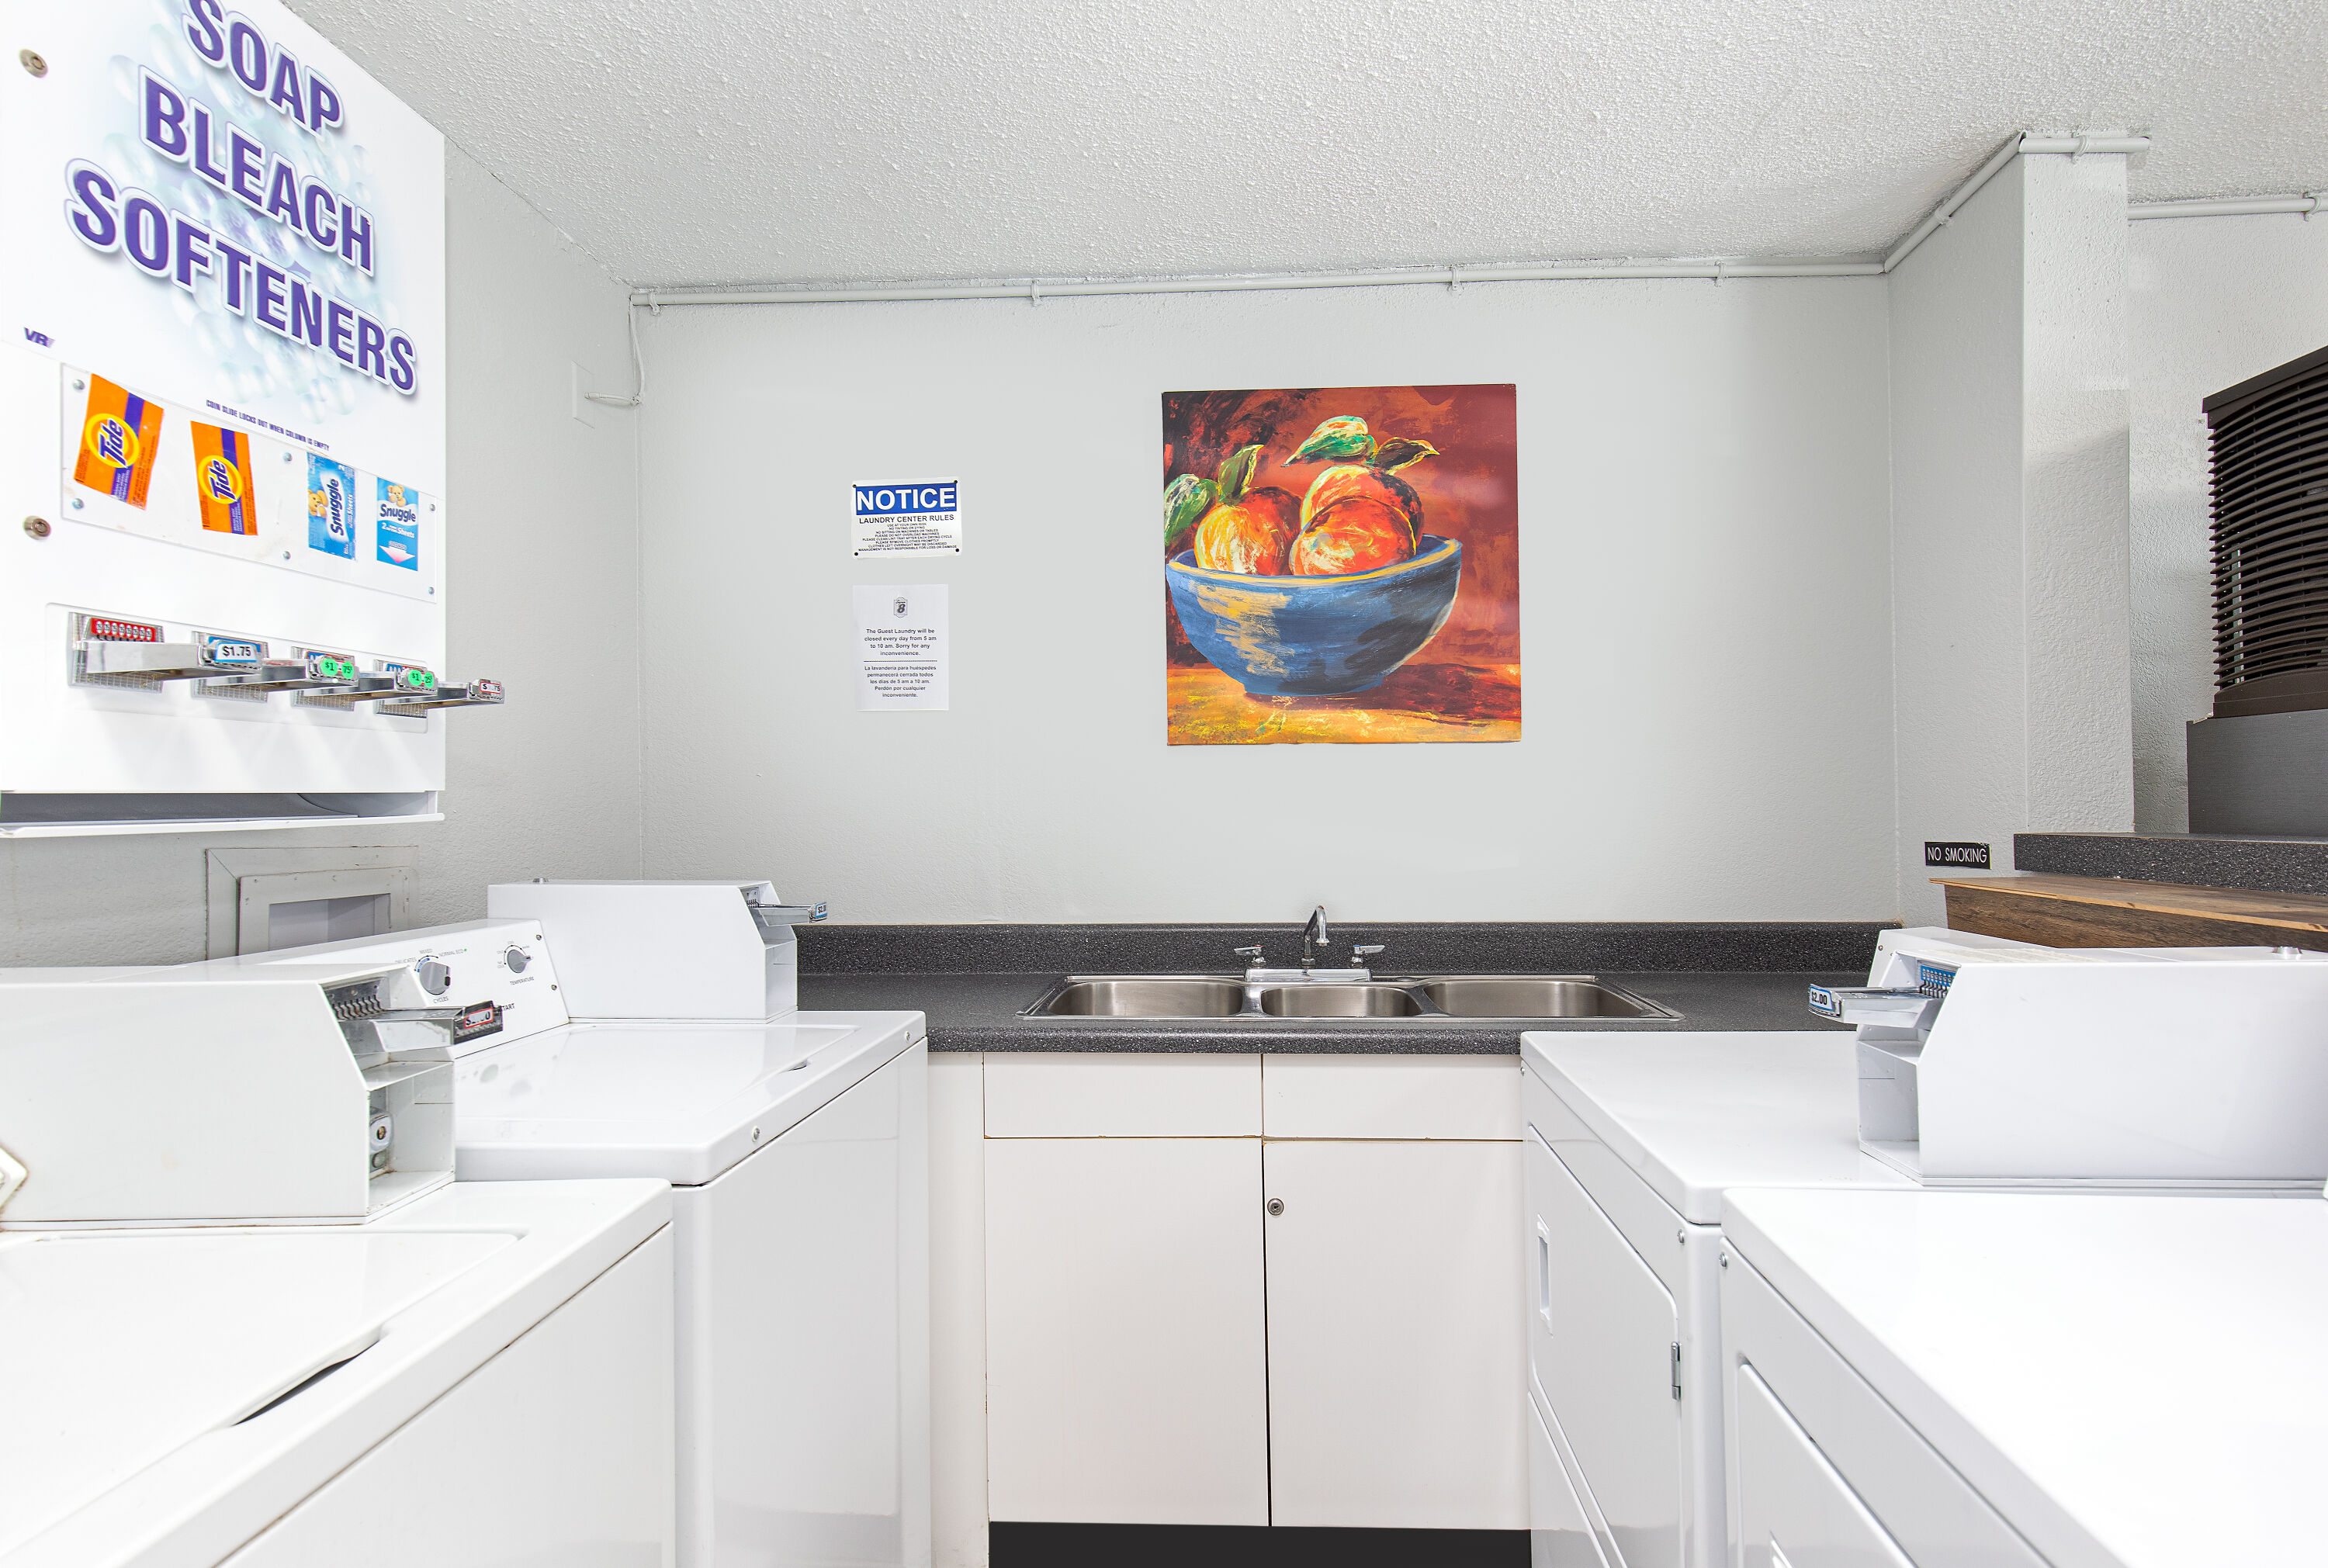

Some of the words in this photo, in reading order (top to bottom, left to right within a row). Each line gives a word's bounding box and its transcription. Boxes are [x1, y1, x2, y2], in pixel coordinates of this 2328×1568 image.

[185, 0, 341, 133] SOAP
[143, 71, 373, 273] BLEACH
[69, 164, 417, 393] SOFTENERS
[99, 418, 127, 467] Tide
[208, 459, 240, 502] Tide
[327, 478, 345, 536] Snuggle
[857, 487, 955, 511] NOTICE
[379, 504, 416, 523] Snuggle
[897, 603, 906, 614] 8
[222, 645, 252, 657] $1.75
[325, 662, 334, 672] $1
[412, 673, 420, 682] $1
[1928, 846, 1942, 861] NO
[1945, 847, 1987, 864] SMOKING
[509, 976, 535, 985] TEMPERATURE
[433, 995, 449, 1004] CYCLES
[501, 1002, 515, 1012] TART
[1810, 992, 1828, 1006] $2.00
